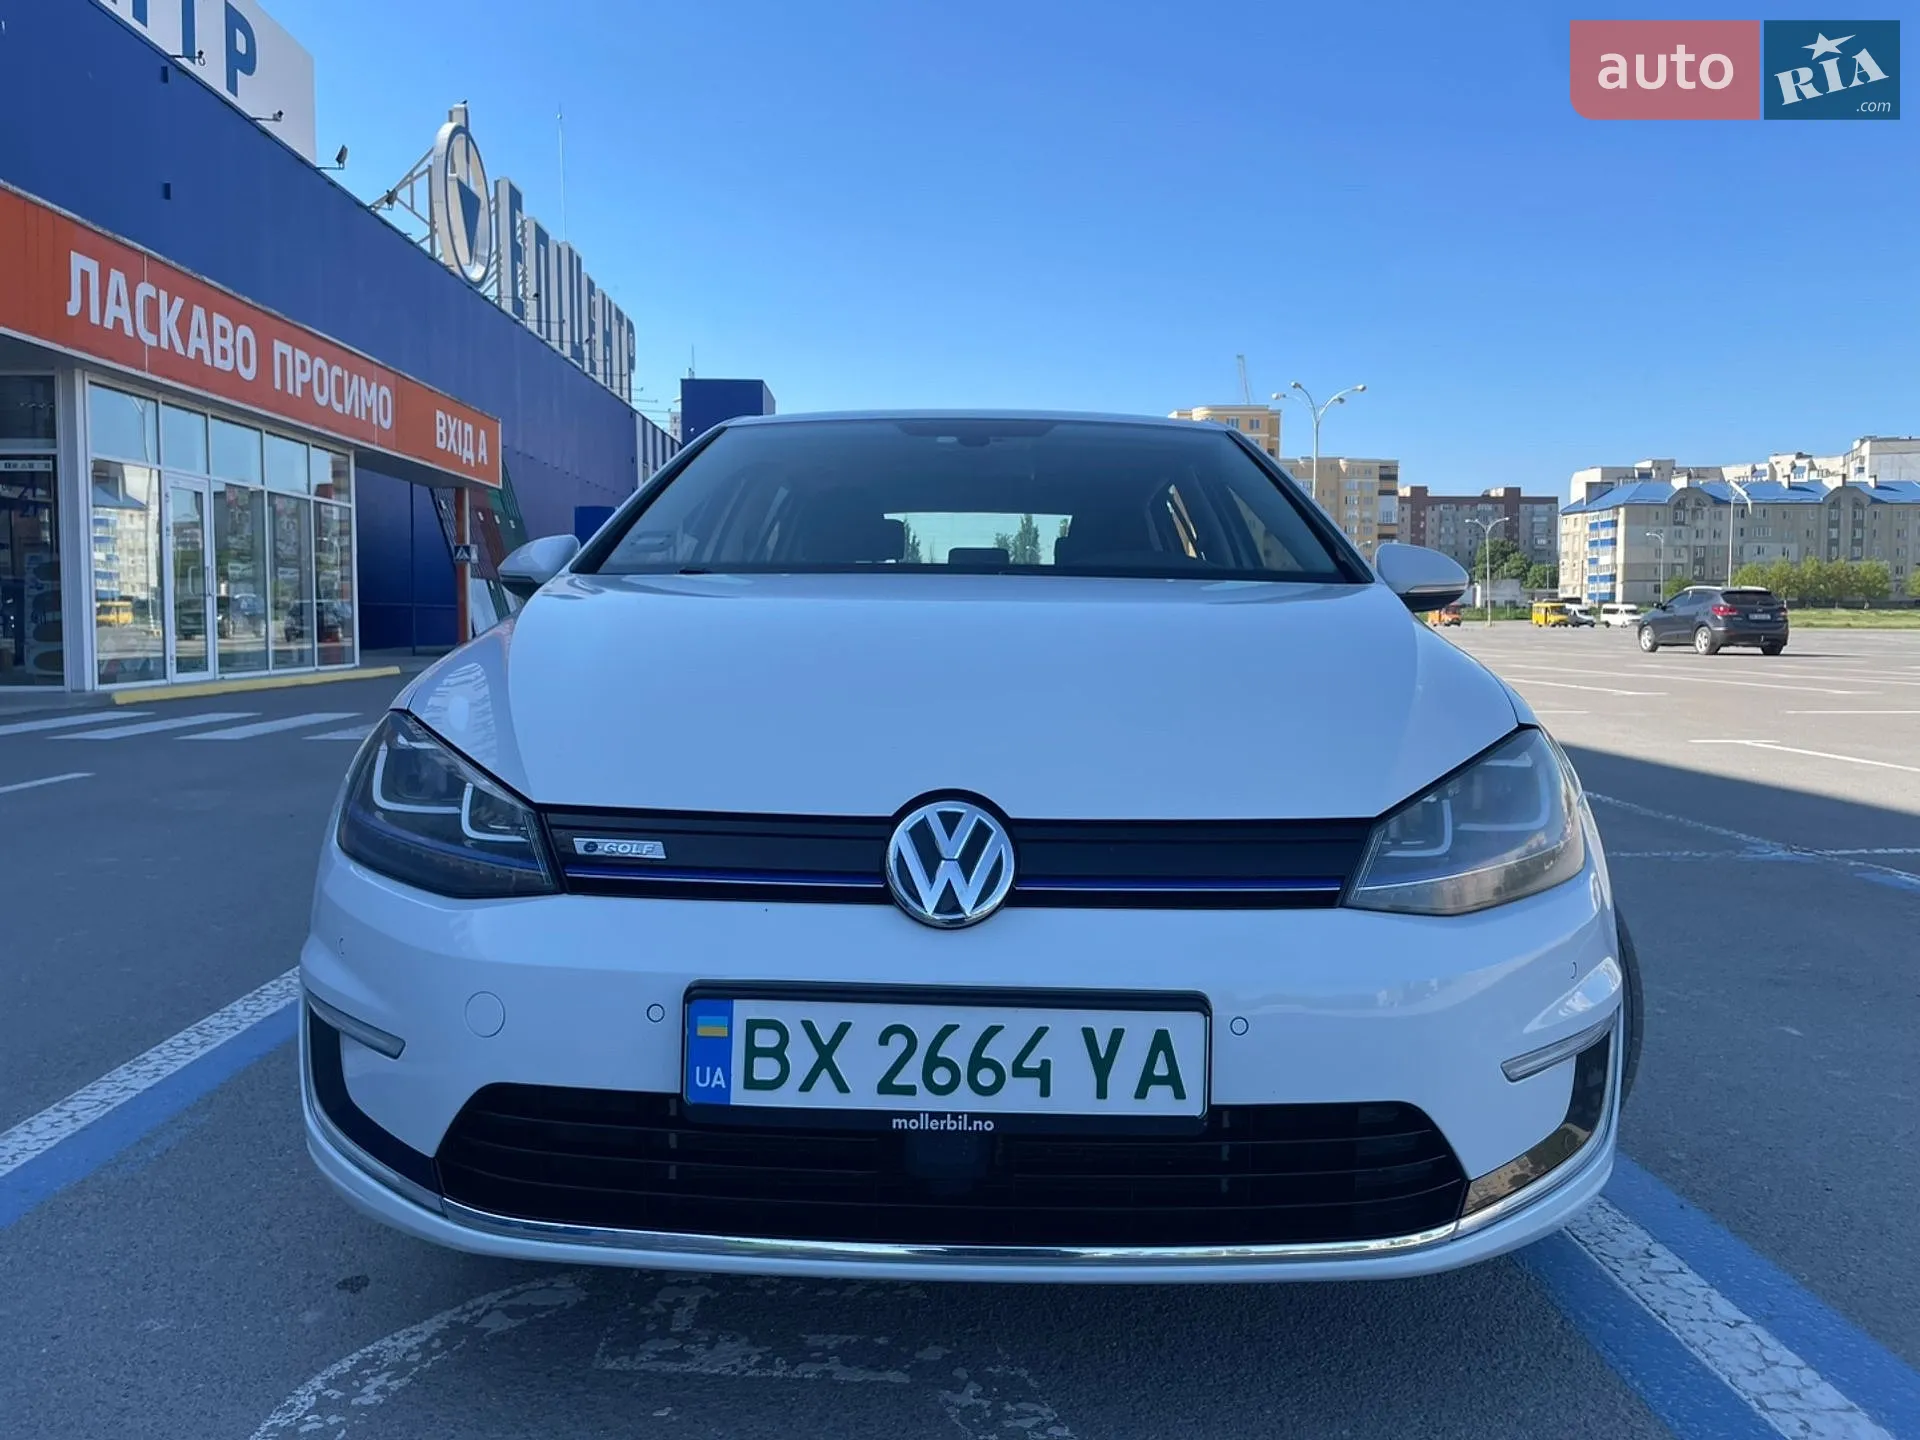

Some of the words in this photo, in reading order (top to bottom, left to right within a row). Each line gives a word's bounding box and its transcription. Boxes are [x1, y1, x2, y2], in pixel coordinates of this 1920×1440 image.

[67, 250, 257, 382] ЛАСКАВО
[272, 339, 393, 431] ПРОСИМО
[435, 409, 475, 466] ВХІД
[478, 431, 488, 466] А
[695, 1066, 726, 1089] UA
[743, 1018, 852, 1093] BX
[877, 1024, 1052, 1096] 2664
[1082, 1027, 1187, 1099] YA
[891, 1114, 995, 1133] mollerbil.no
